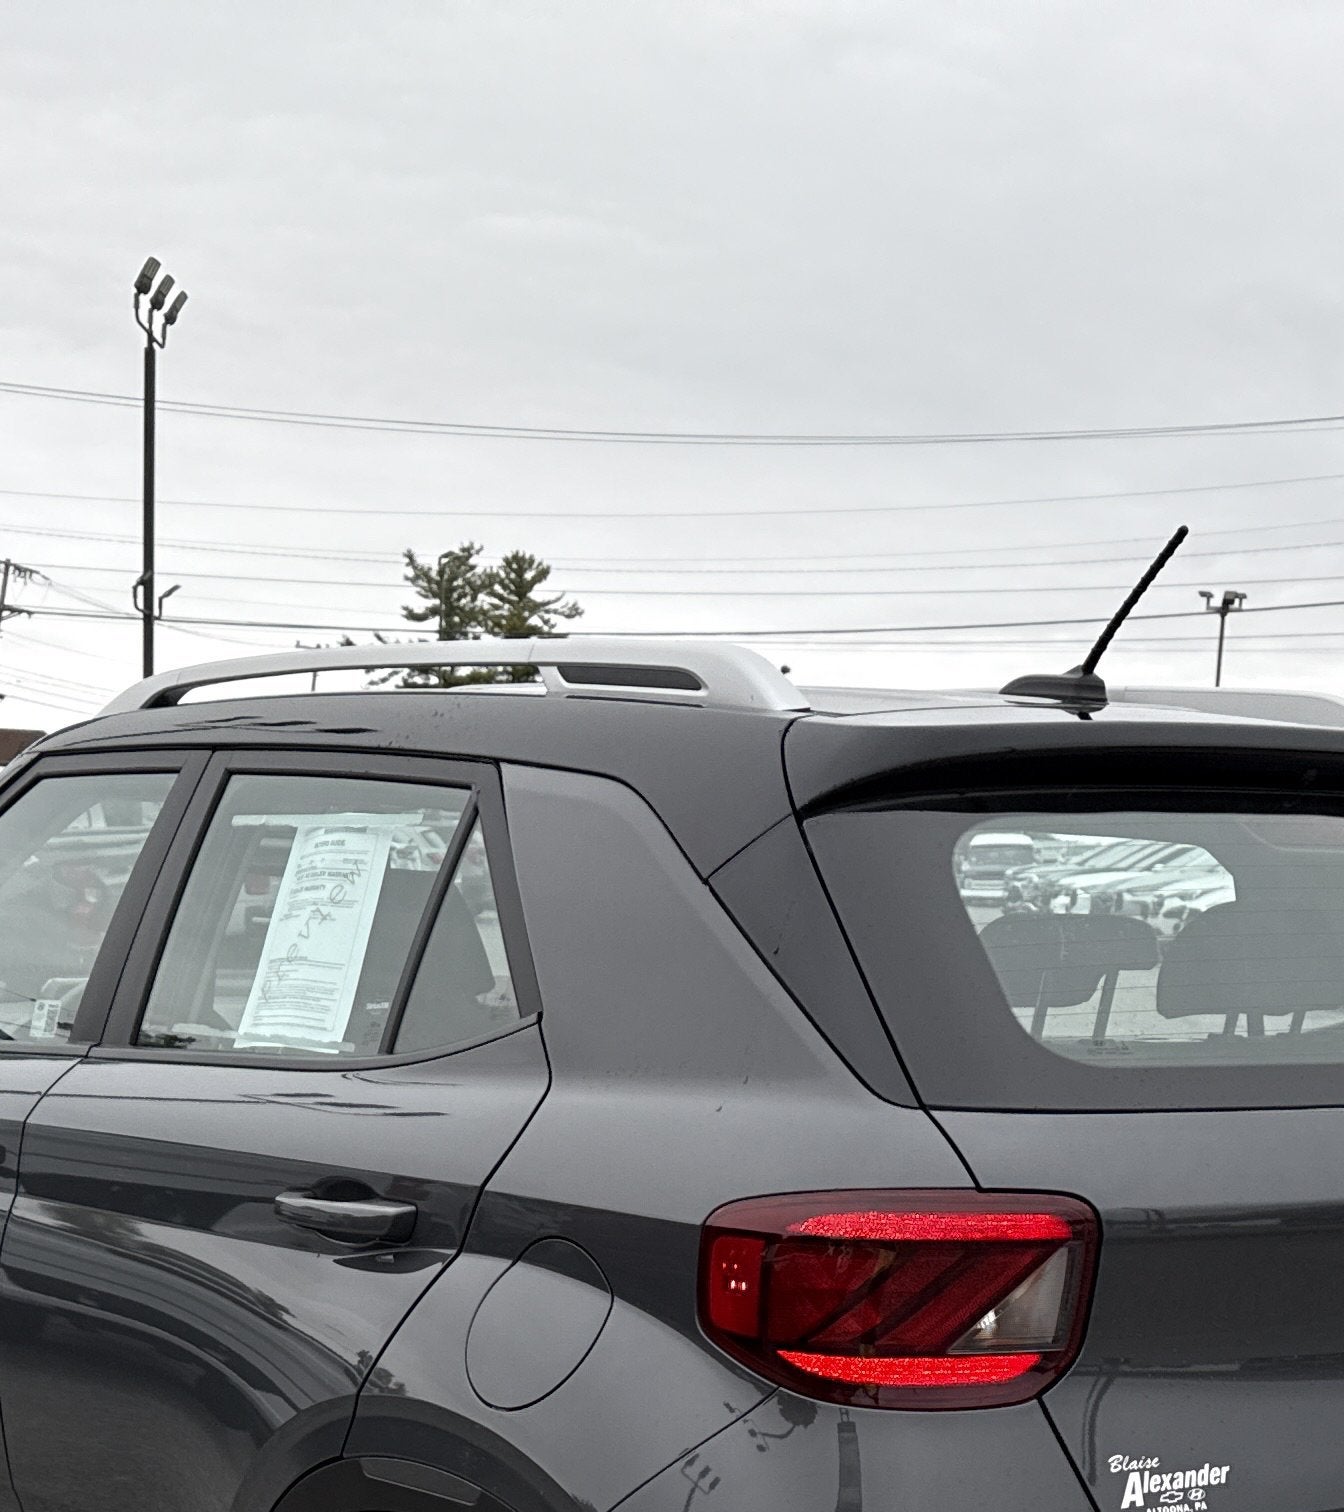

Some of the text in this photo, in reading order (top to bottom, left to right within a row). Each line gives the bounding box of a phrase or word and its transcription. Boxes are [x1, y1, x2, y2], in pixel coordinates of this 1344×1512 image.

[1107, 1454, 1161, 1473] Blaise
[1120, 1462, 1231, 1510] Alexander
[1194, 1500, 1208, 1511] PA
